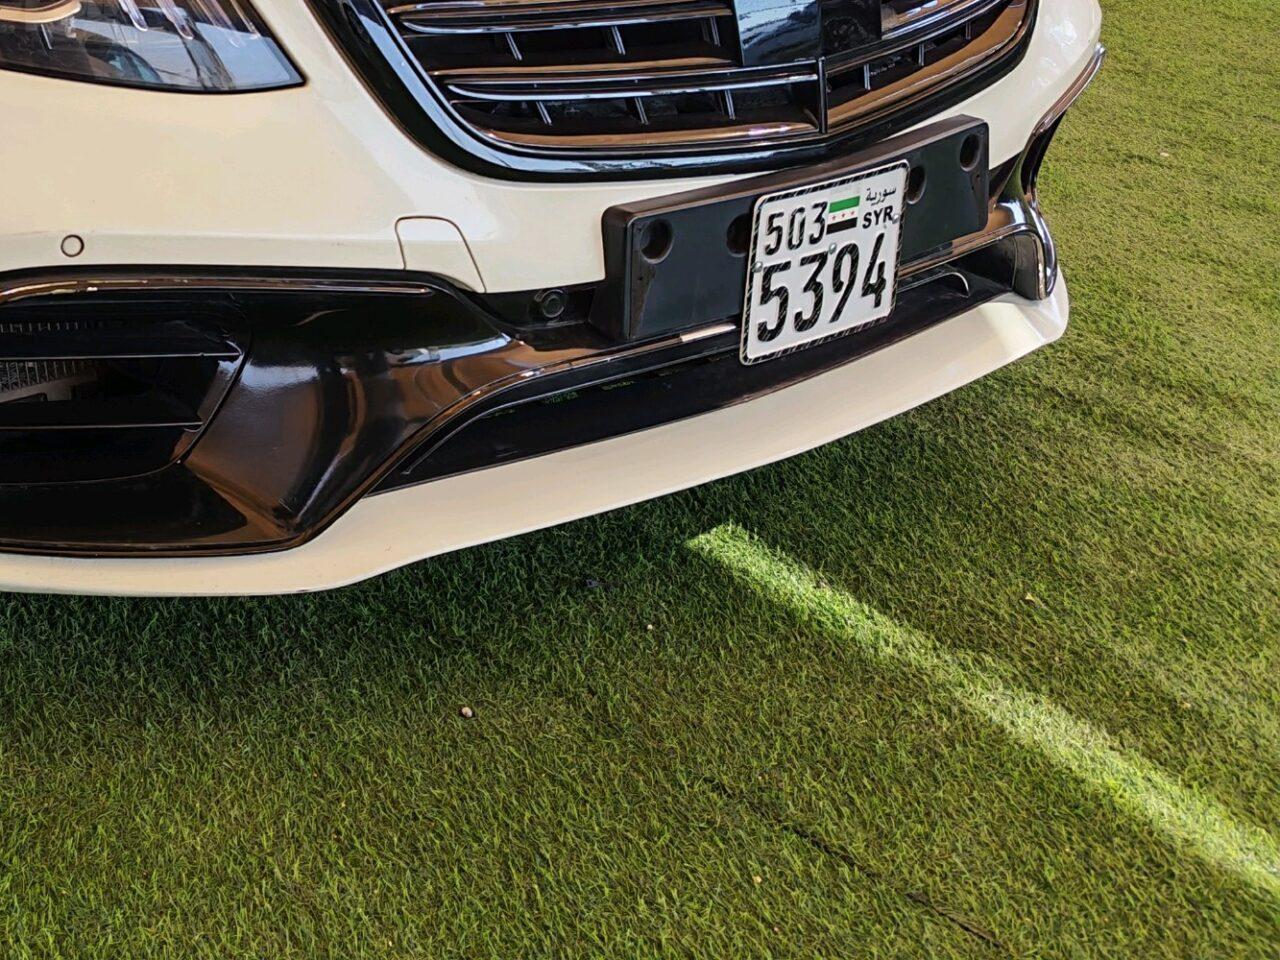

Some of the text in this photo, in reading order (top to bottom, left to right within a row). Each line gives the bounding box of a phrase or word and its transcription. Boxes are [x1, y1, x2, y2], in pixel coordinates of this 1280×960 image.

[865, 187, 897, 207] سورية
[764, 200, 829, 256] 503
[862, 205, 894, 230] SYR
[756, 232, 887, 343] 5394
